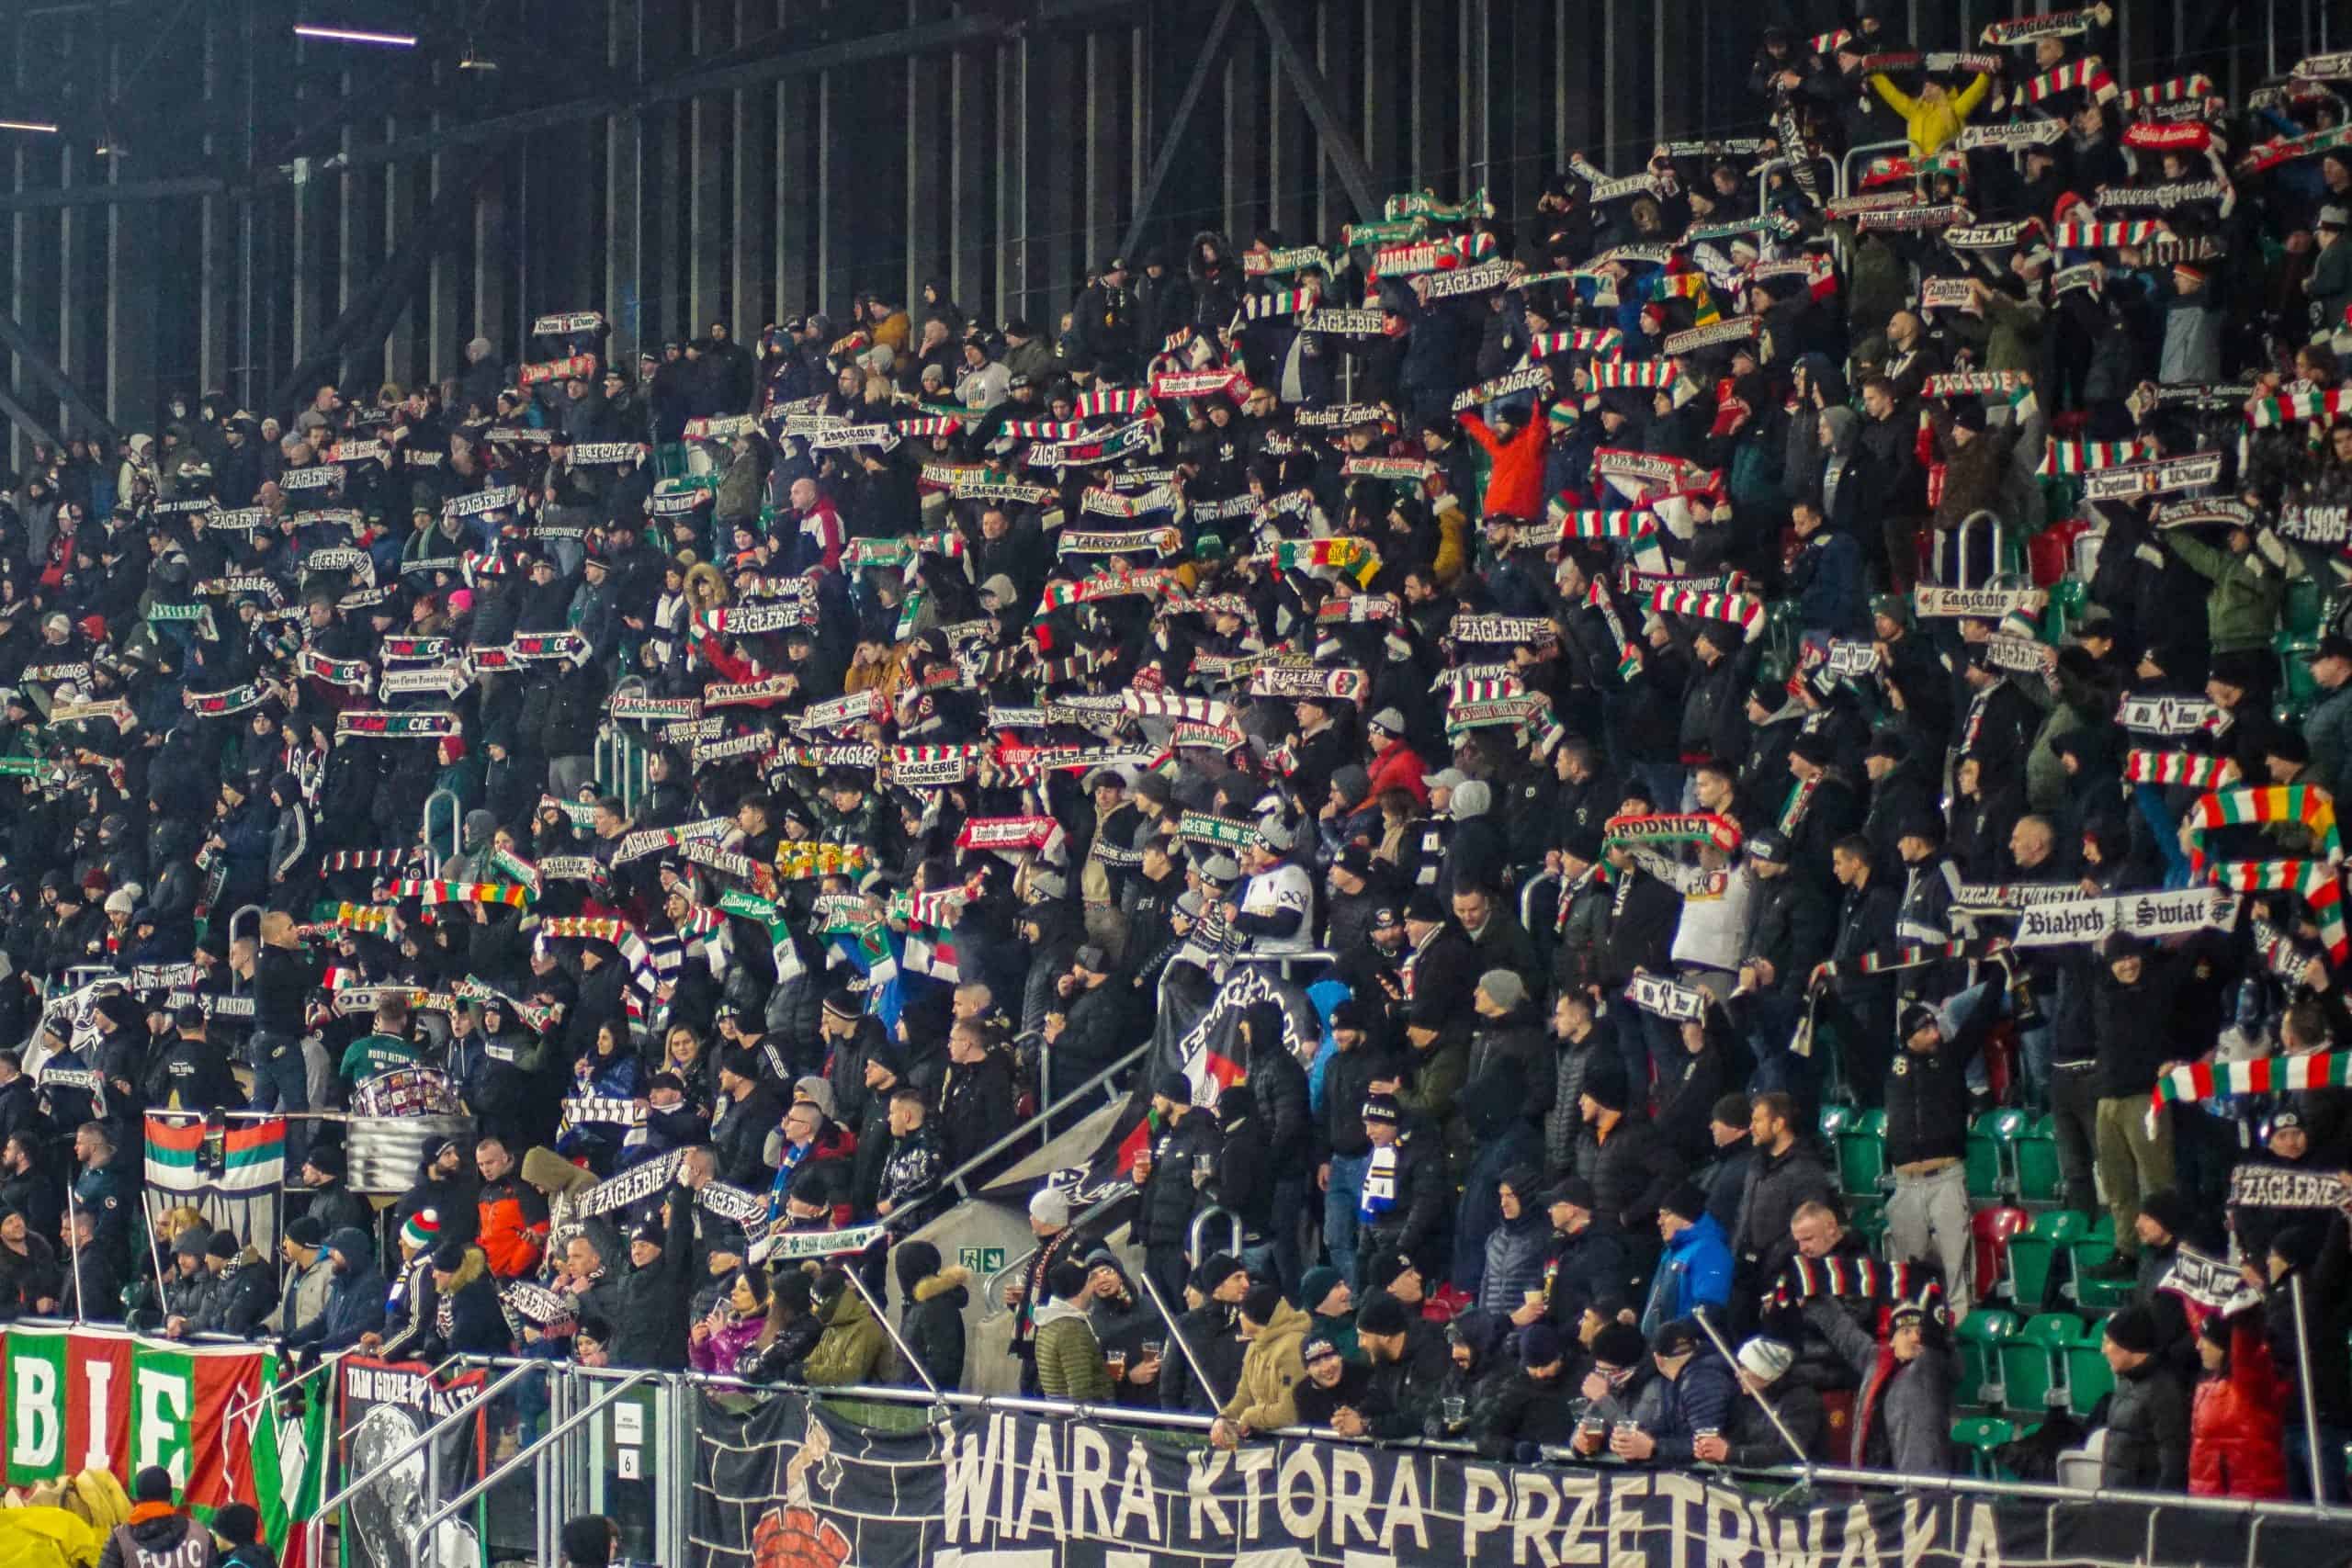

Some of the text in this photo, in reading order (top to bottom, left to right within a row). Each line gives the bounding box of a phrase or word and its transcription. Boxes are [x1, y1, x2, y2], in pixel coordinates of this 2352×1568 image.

[2025, 908, 2104, 939] Białych
[625, 1455, 631, 1472] 6
[939, 1413, 1160, 1543] WIARA
